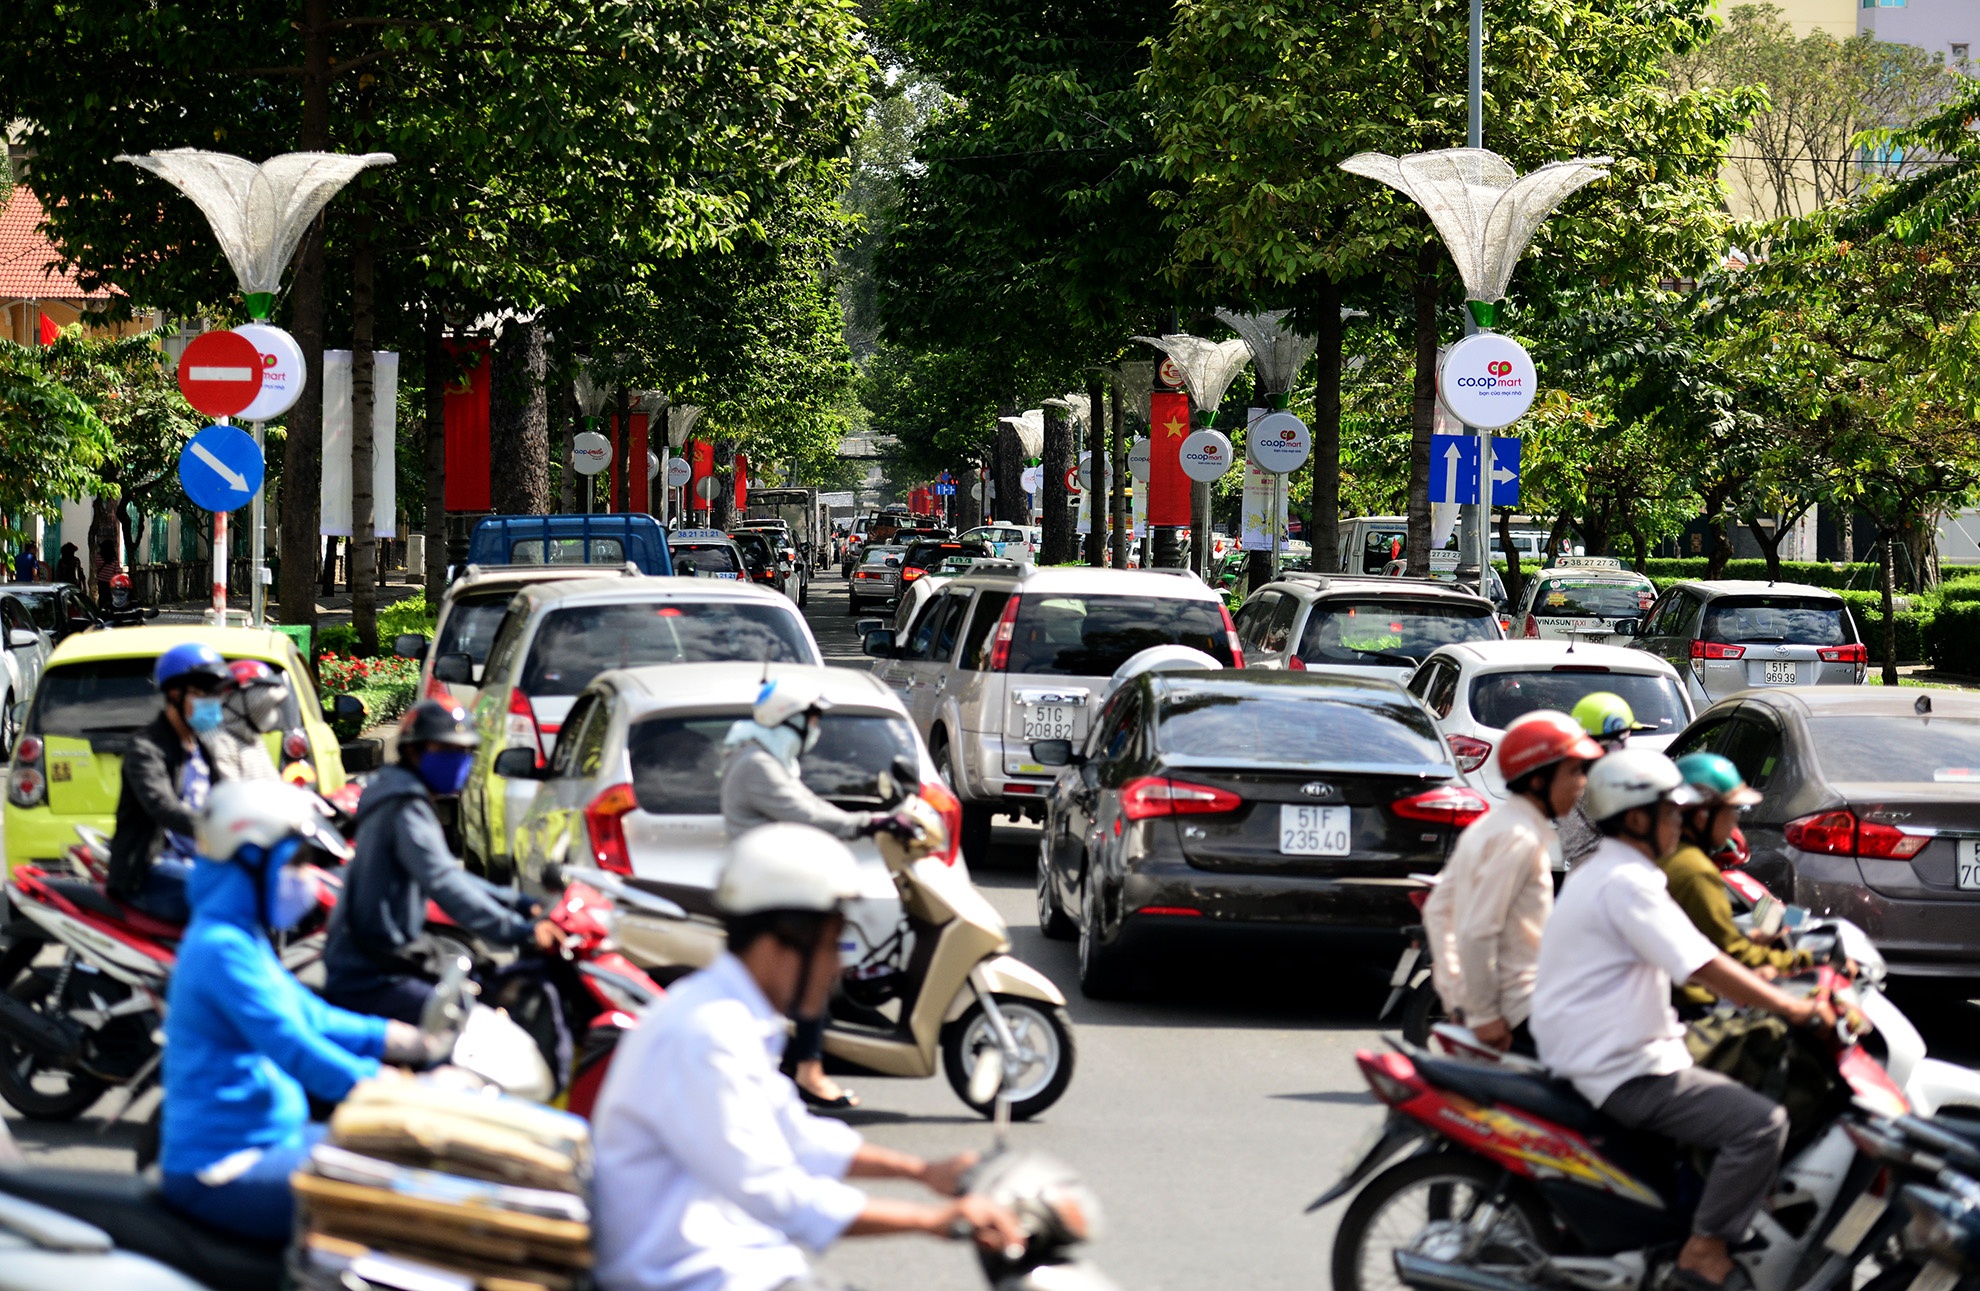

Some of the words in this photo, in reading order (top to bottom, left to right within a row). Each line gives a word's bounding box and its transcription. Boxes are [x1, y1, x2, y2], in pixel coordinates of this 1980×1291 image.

[1570, 559, 1595, 567] 38.27
[1772, 663, 1788, 673] 51F
[1766, 672, 1796, 684] 969.39
[1036, 706, 1063, 722] 51G
[1026, 722, 1072, 739] 208.82
[1298, 808, 1333, 829] 51F
[1284, 829, 1347, 851] 235.40
